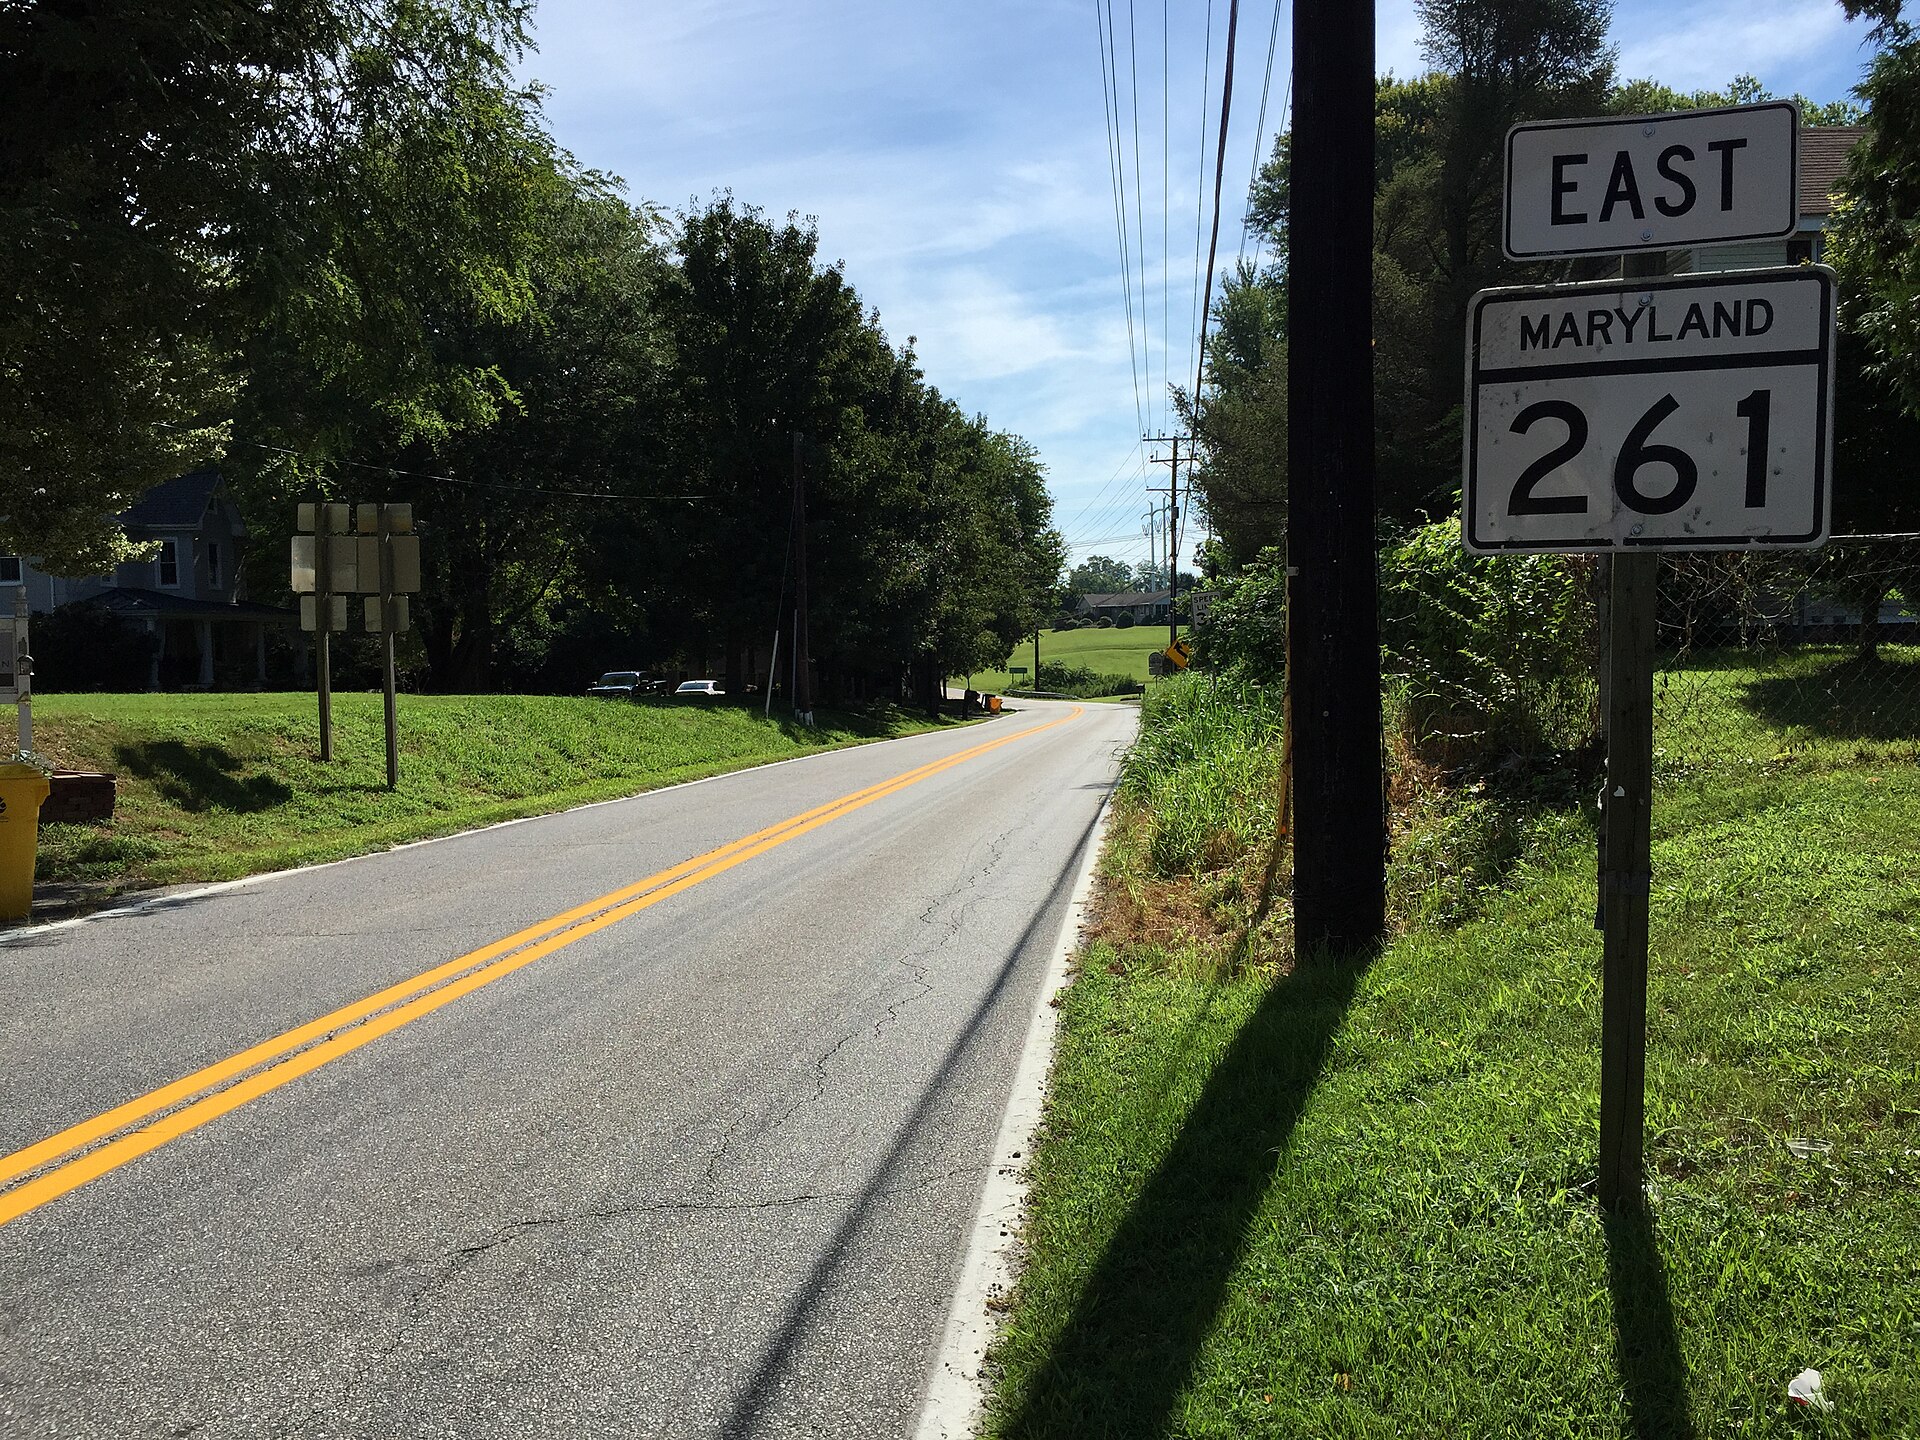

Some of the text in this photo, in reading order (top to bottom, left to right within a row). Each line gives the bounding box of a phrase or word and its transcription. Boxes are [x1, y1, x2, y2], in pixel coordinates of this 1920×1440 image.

[1551, 138, 1747, 226] EAST
[1520, 298, 1774, 350] MARYLAND
[1507, 389, 1771, 516] 261
